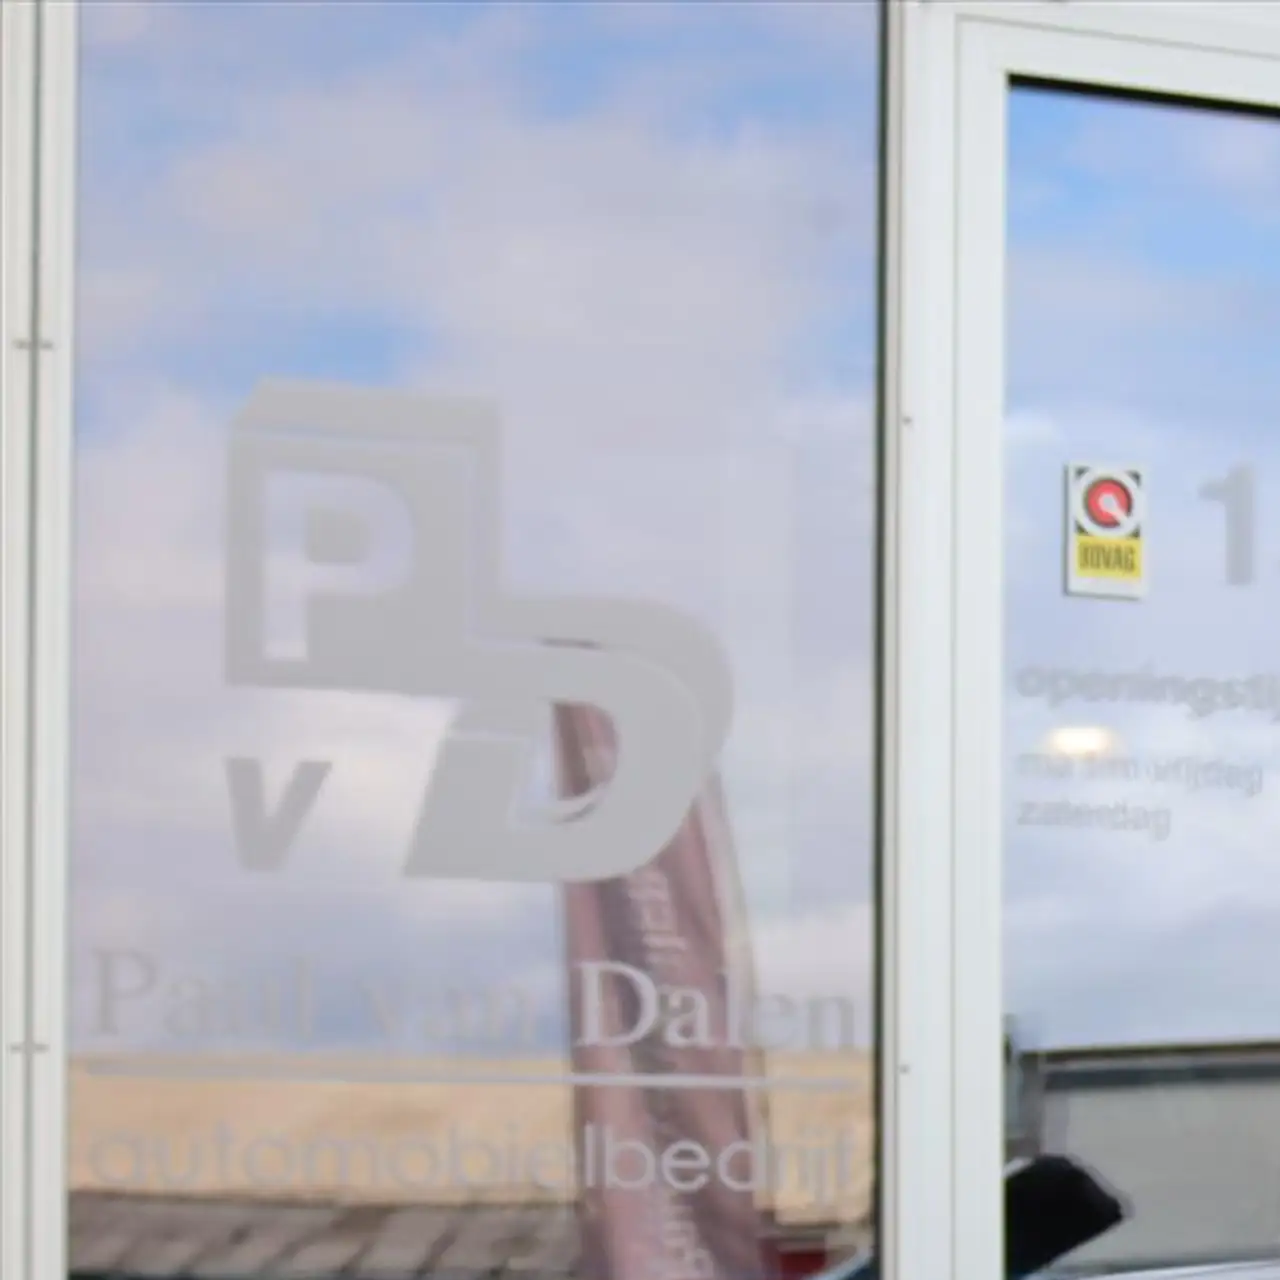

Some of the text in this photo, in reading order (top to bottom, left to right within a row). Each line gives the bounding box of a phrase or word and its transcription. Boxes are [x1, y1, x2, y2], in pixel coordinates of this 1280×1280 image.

[1077, 542, 1137, 573] BOVAG
[90, 944, 317, 1042] Paul
[576, 958, 860, 1053] Dalen
